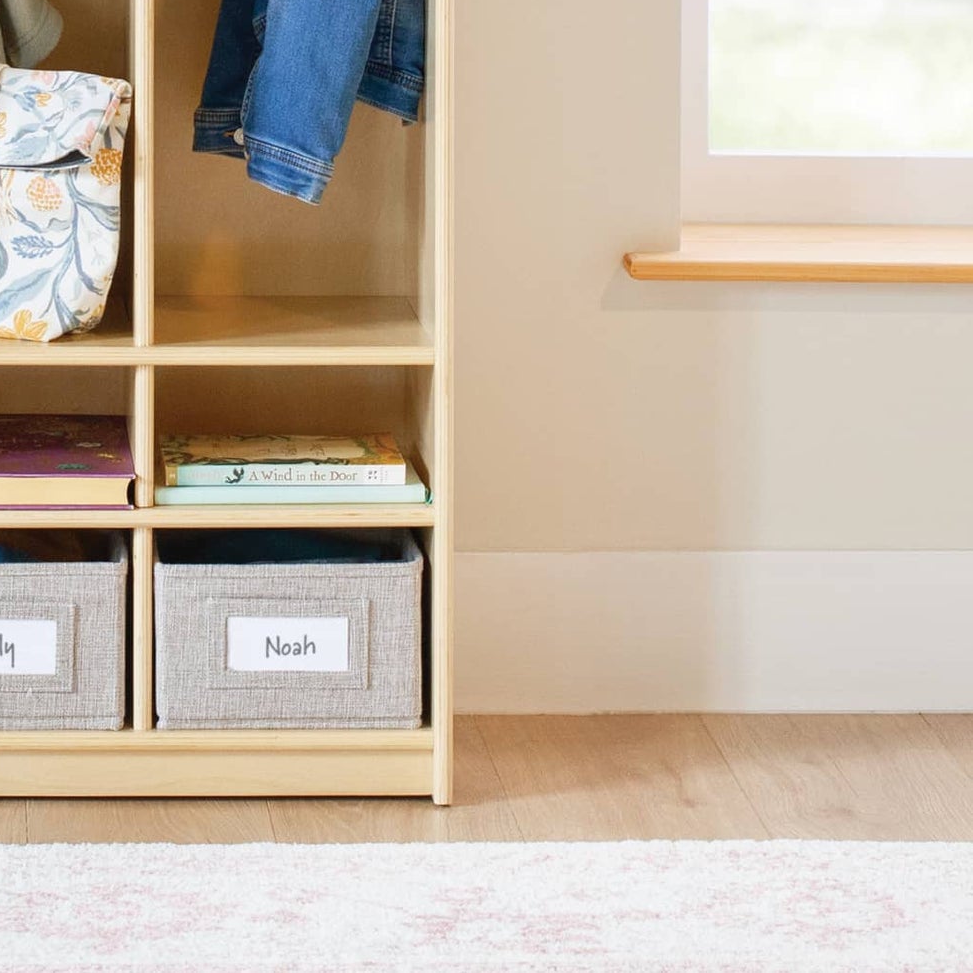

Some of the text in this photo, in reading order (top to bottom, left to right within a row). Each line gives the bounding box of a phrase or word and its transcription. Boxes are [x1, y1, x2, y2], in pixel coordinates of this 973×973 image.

[249, 467, 358, 481] A Wind in the Door
[266, 634, 316, 658] Noah
